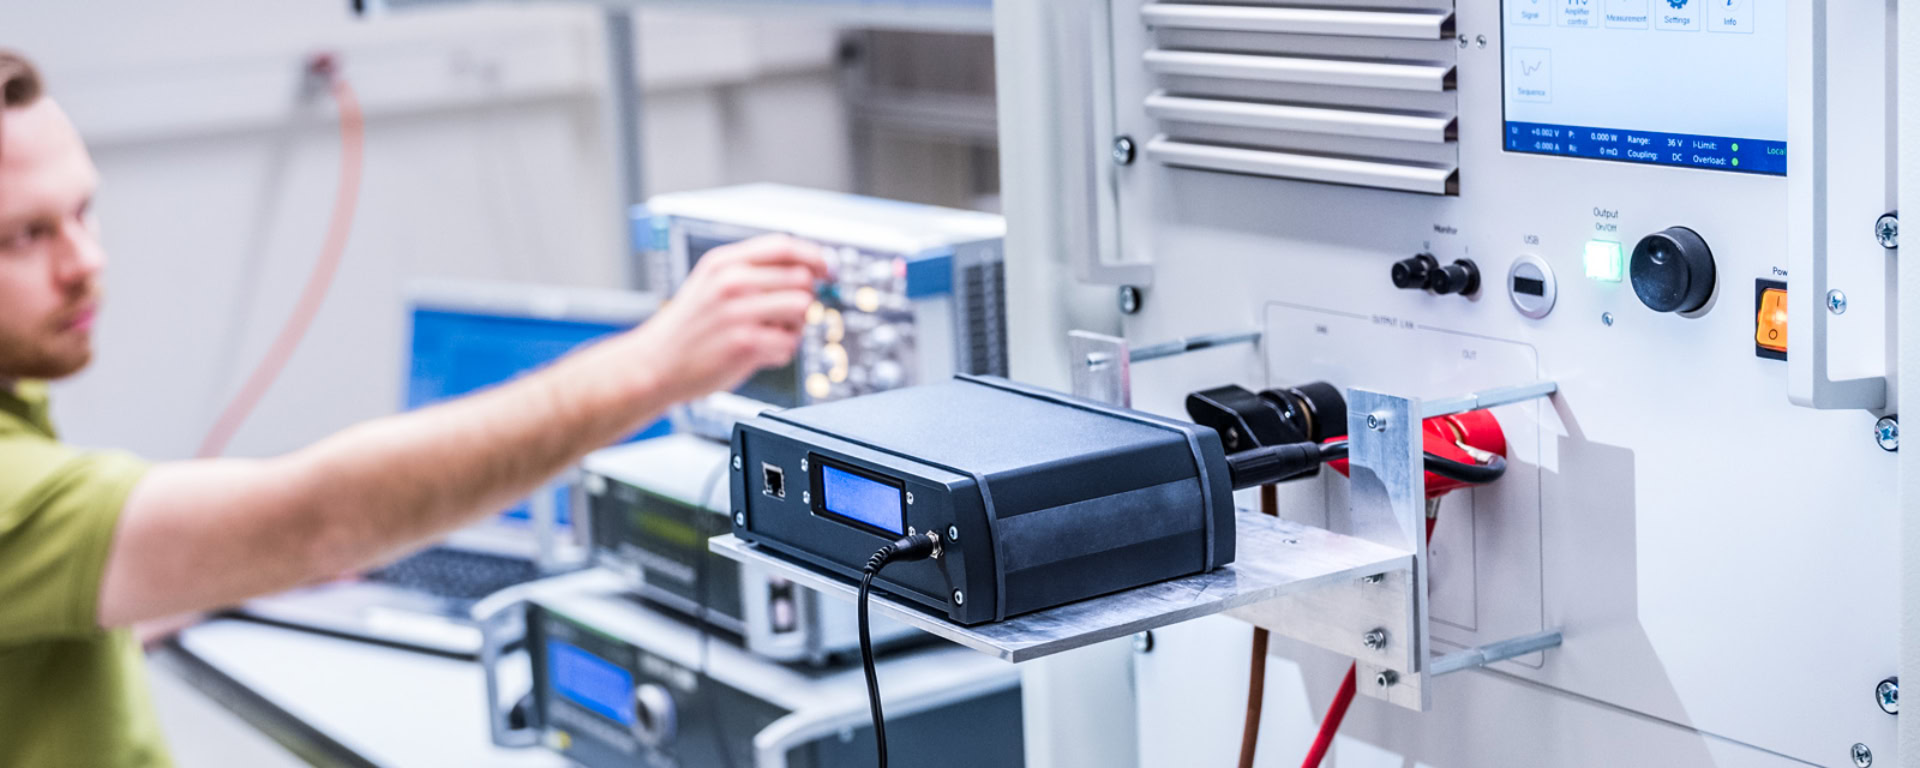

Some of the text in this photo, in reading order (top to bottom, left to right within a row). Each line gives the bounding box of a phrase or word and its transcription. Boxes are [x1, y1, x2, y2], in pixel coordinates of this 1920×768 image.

[1522, 10, 1539, 20] Signal
[1606, 14, 1647, 22] Measurement
[1664, 16, 1690, 26] Settings
[1724, 18, 1737, 26] Info
[1554, 130, 1560, 138] V
[1591, 132, 1610, 140] 0.000
[1610, 134, 1618, 142] W
[1628, 136, 1682, 147] Range: 36 V
[1693, 140, 1717, 150] I-Limit:
[1600, 146, 1604, 156] 0
[1628, 149, 1682, 162] Coupling: DC
[1693, 154, 1726, 166] Overload:
[1593, 206, 1619, 218] Output
[1433, 224, 1458, 234] Monitor
[1596, 222, 1617, 232] On/Off
[1524, 234, 1540, 245] USB
[1462, 350, 1477, 360] OUT
